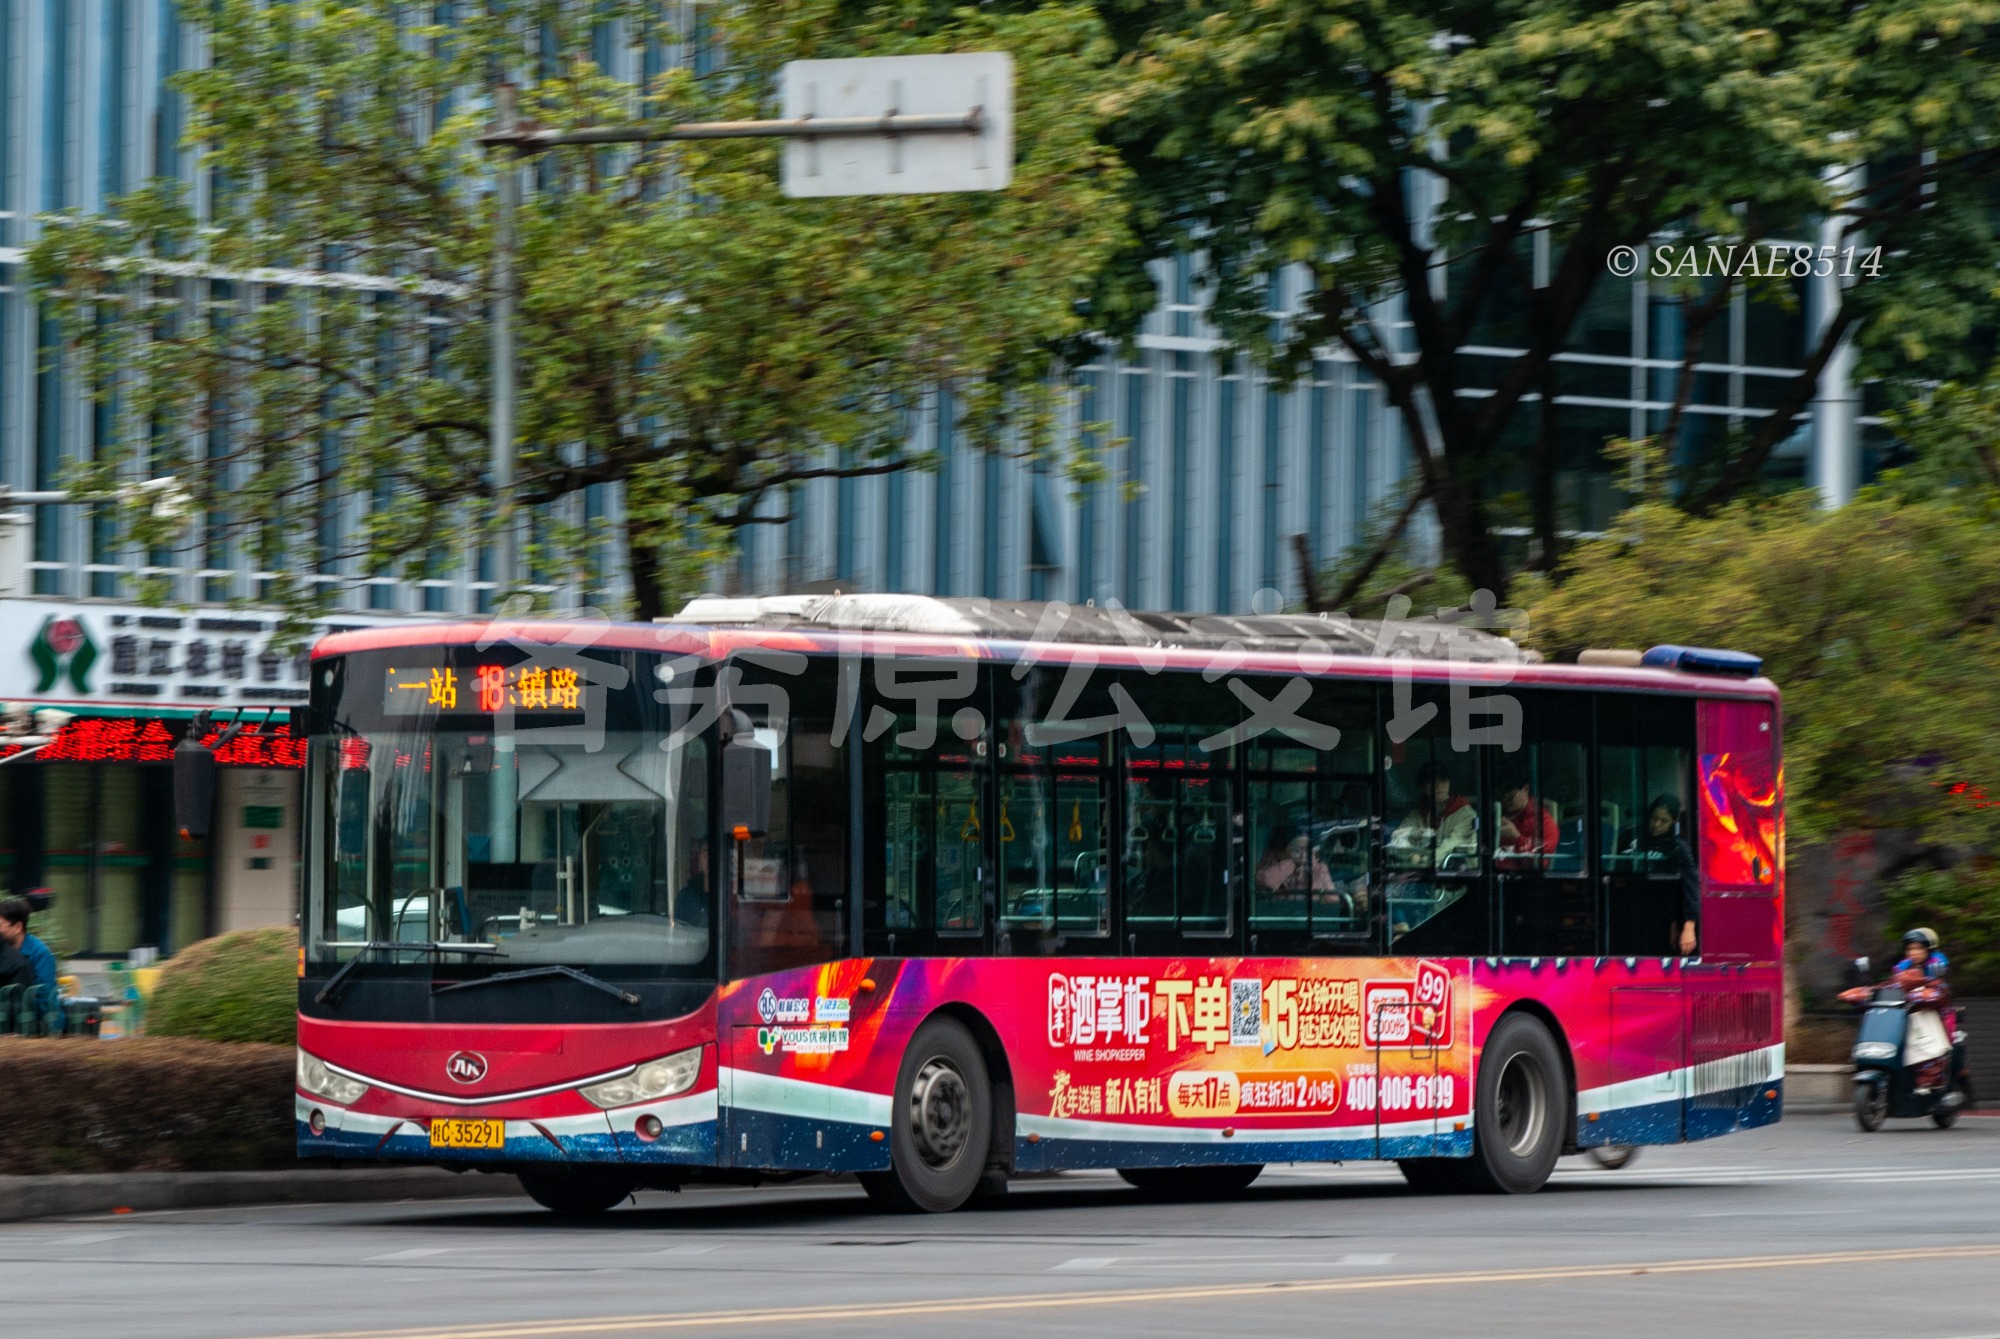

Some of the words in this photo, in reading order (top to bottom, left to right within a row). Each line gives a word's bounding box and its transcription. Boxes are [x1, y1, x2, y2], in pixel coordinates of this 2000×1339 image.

[389, 667, 458, 709] 一站
[477, 665, 504, 711] 18
[1070, 976, 1150, 1044] 酒掌柜
[1155, 976, 1230, 1053] 下单
[1299, 979, 1359, 1013] 分钟开喝
[1299, 1013, 1359, 1047] 延迟必赔
[1074, 1049, 1094, 1062] WINE
[1095, 1049, 1146, 1062] SHOPKEEPER
[1105, 1077, 1163, 1115] 新人有礼
